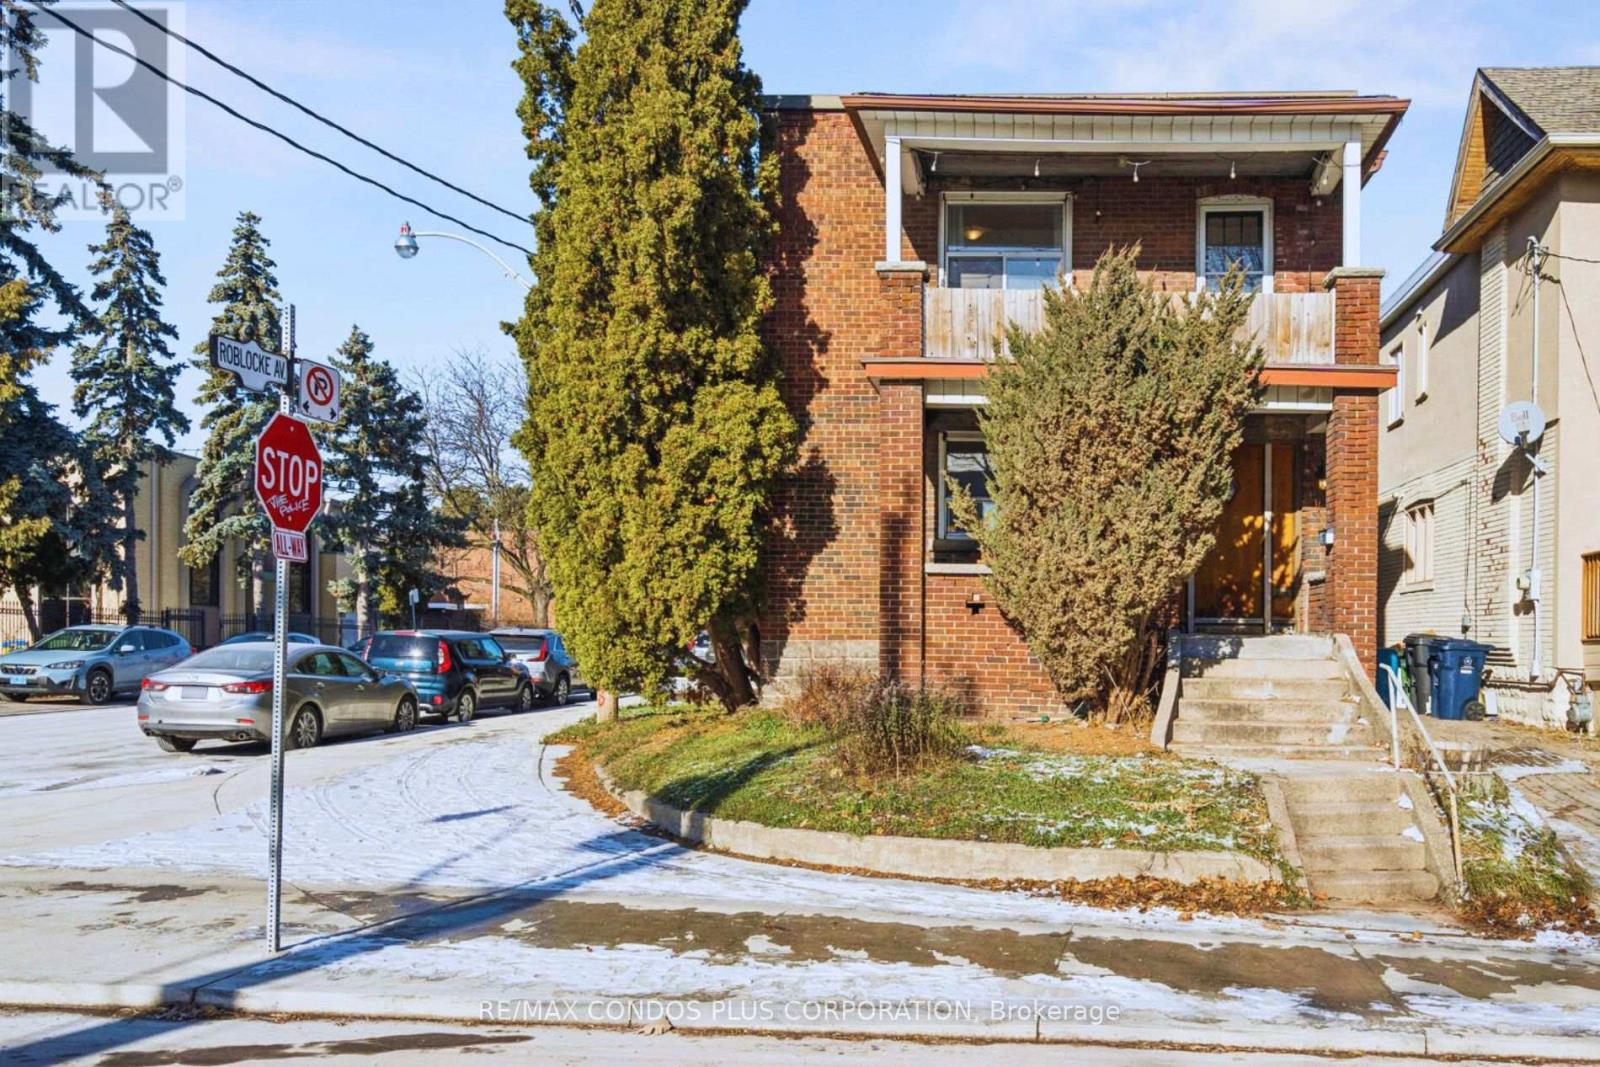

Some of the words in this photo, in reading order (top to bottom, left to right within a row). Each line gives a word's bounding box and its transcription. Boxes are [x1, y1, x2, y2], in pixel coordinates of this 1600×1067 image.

[219, 342, 271, 376] ROBLOCKE
[261, 446, 318, 500] STOP
[276, 533, 304, 559] ALL-WAY
